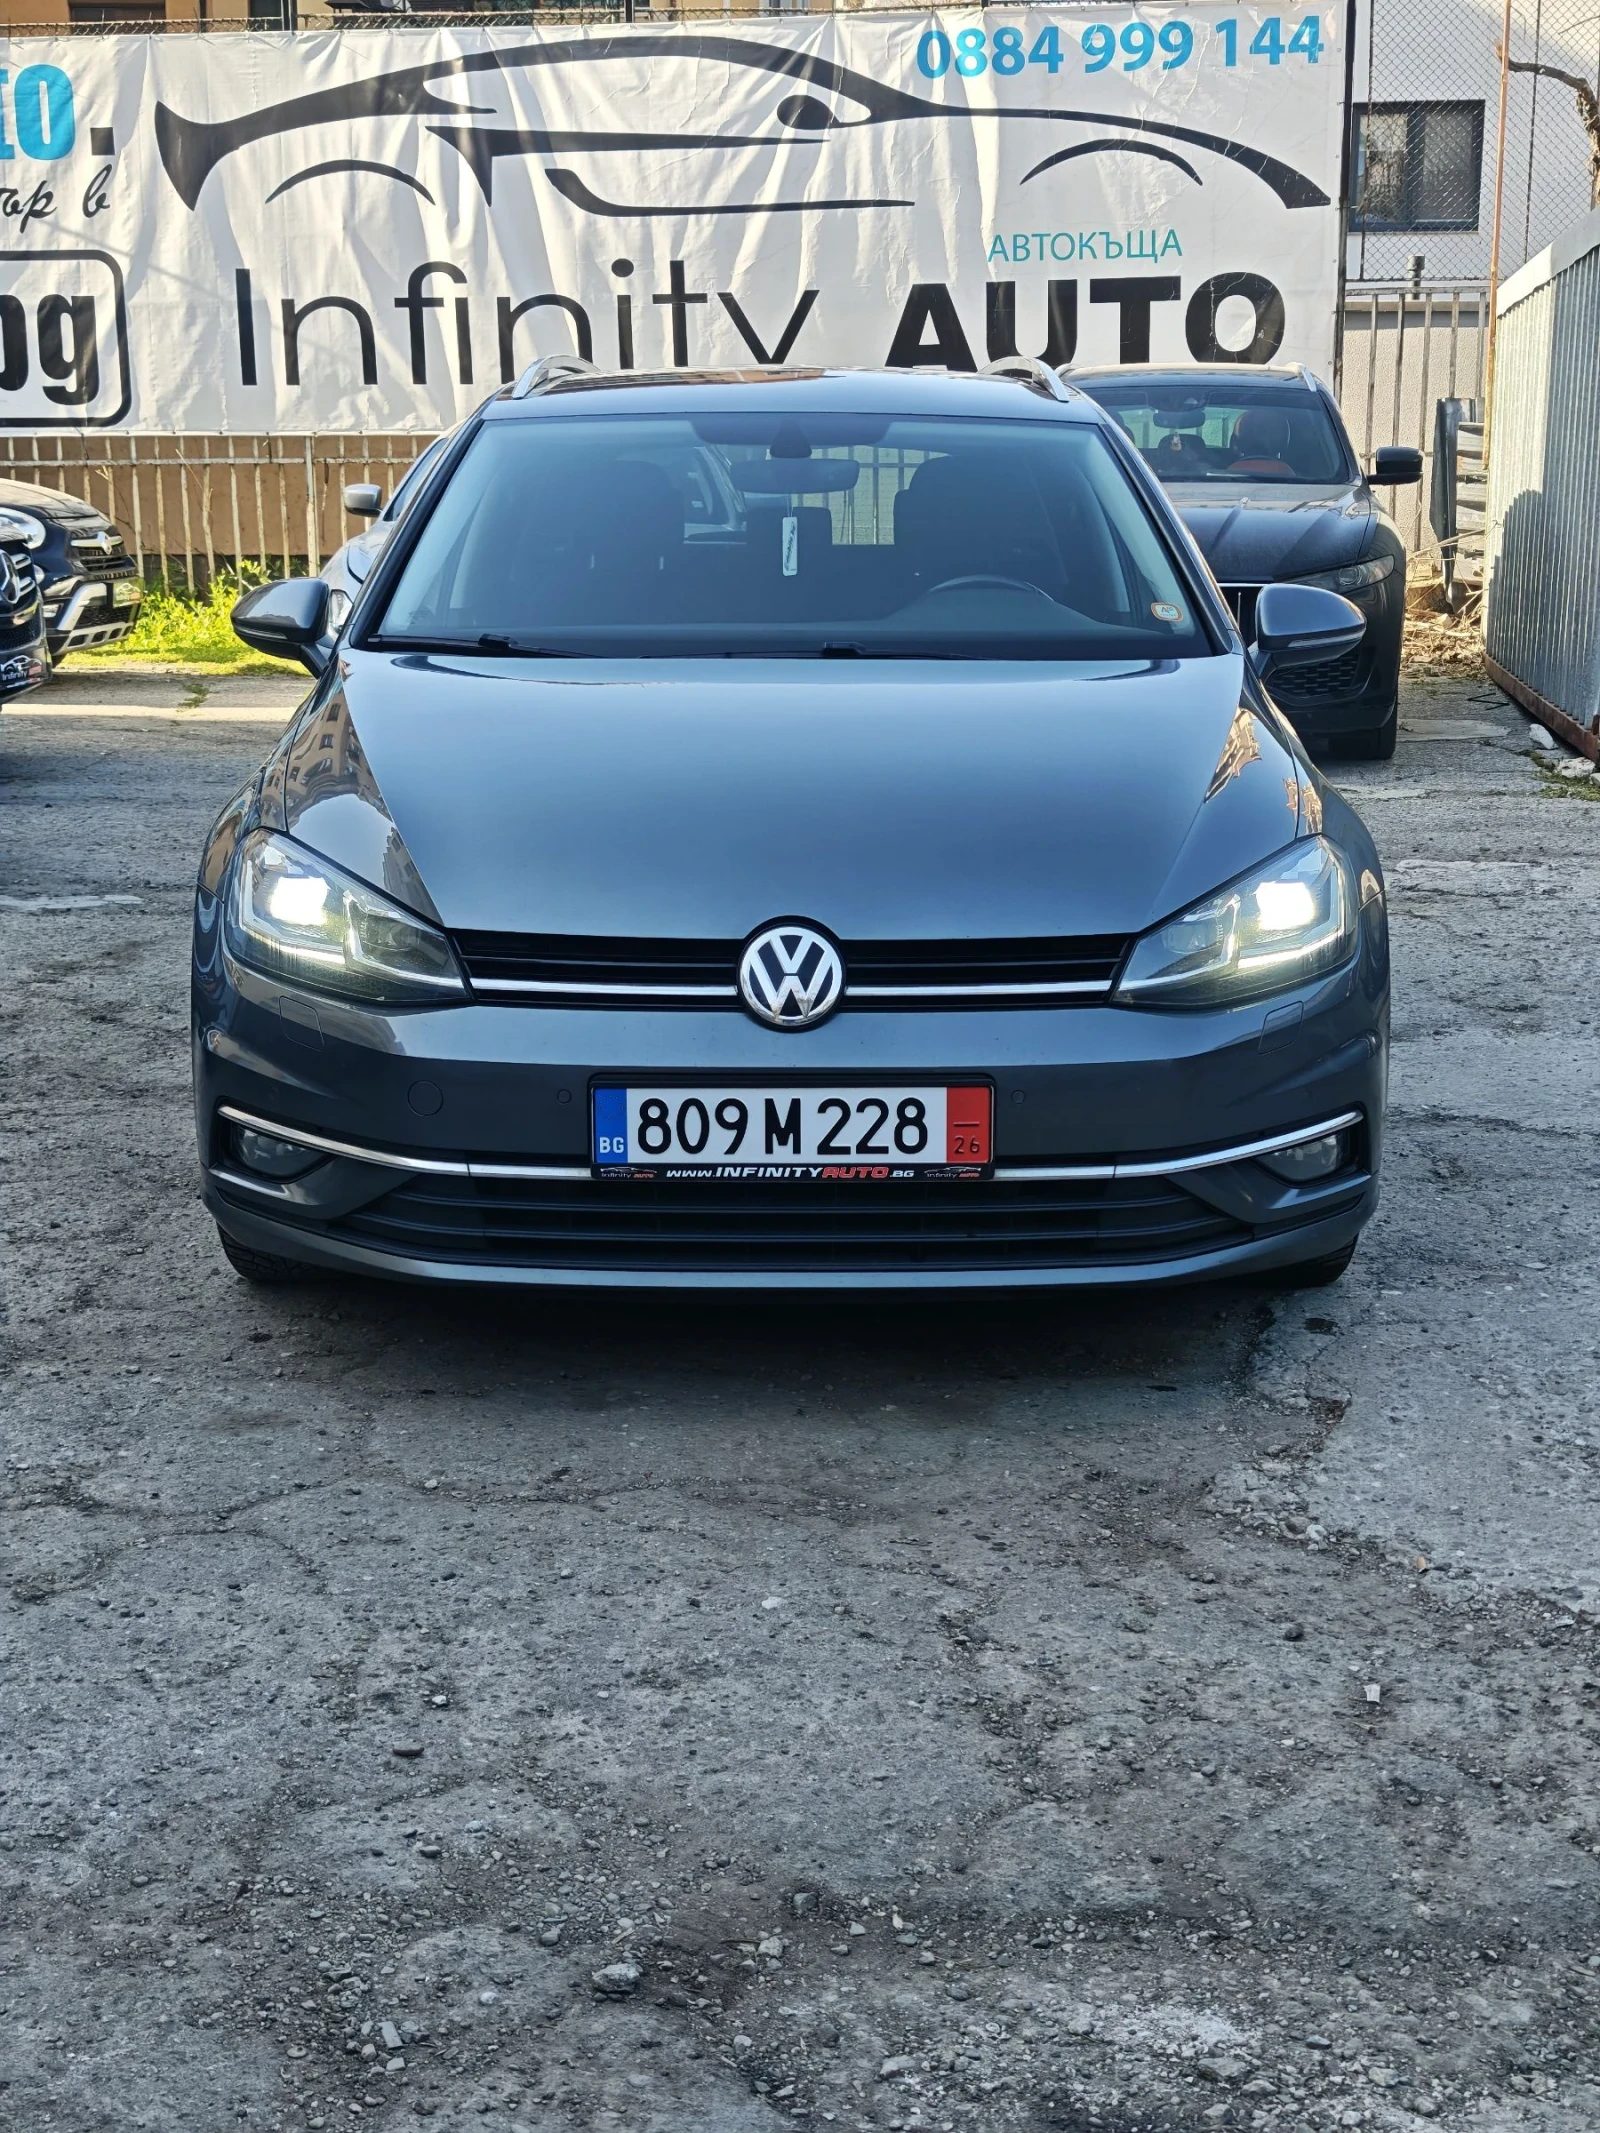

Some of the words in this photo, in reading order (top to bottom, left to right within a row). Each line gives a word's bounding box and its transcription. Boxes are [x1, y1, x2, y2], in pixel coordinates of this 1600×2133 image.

[916, 26, 1064, 79] 0884
[1081, 20, 1194, 73] 999
[1215, 15, 1325, 67] 144
[987, 228, 1183, 264] АВТОКЪЩА
[885, 271, 1286, 375] AUTO
[599, 1137, 625, 1154] BG
[637, 1097, 749, 1155] 809
[764, 1098, 801, 1155] M
[817, 1097, 928, 1155] 228
[953, 1136, 981, 1154] 26
